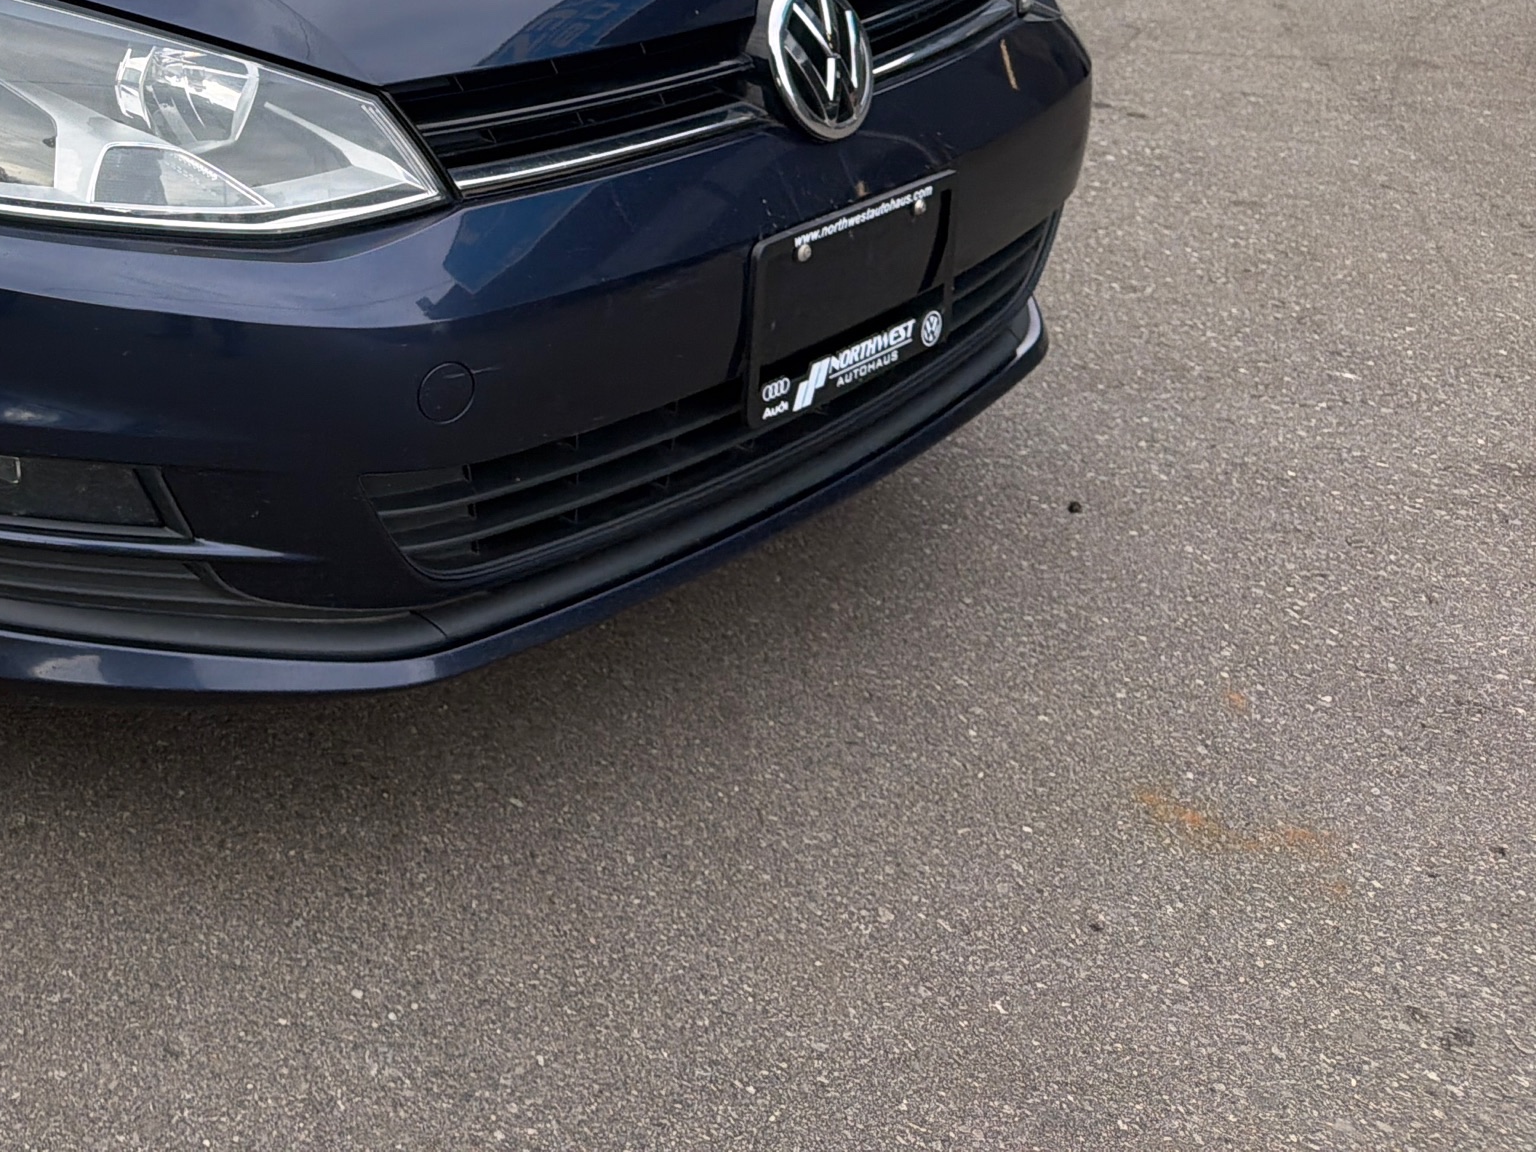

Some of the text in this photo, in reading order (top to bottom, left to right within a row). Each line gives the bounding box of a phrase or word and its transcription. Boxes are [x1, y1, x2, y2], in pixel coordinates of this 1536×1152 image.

[793, 185, 934, 248] www.northwestautohaus.com
[828, 318, 917, 375] NORTHWEST
[835, 349, 899, 388] AUTOHAUS
[762, 400, 789, 420] Audi
